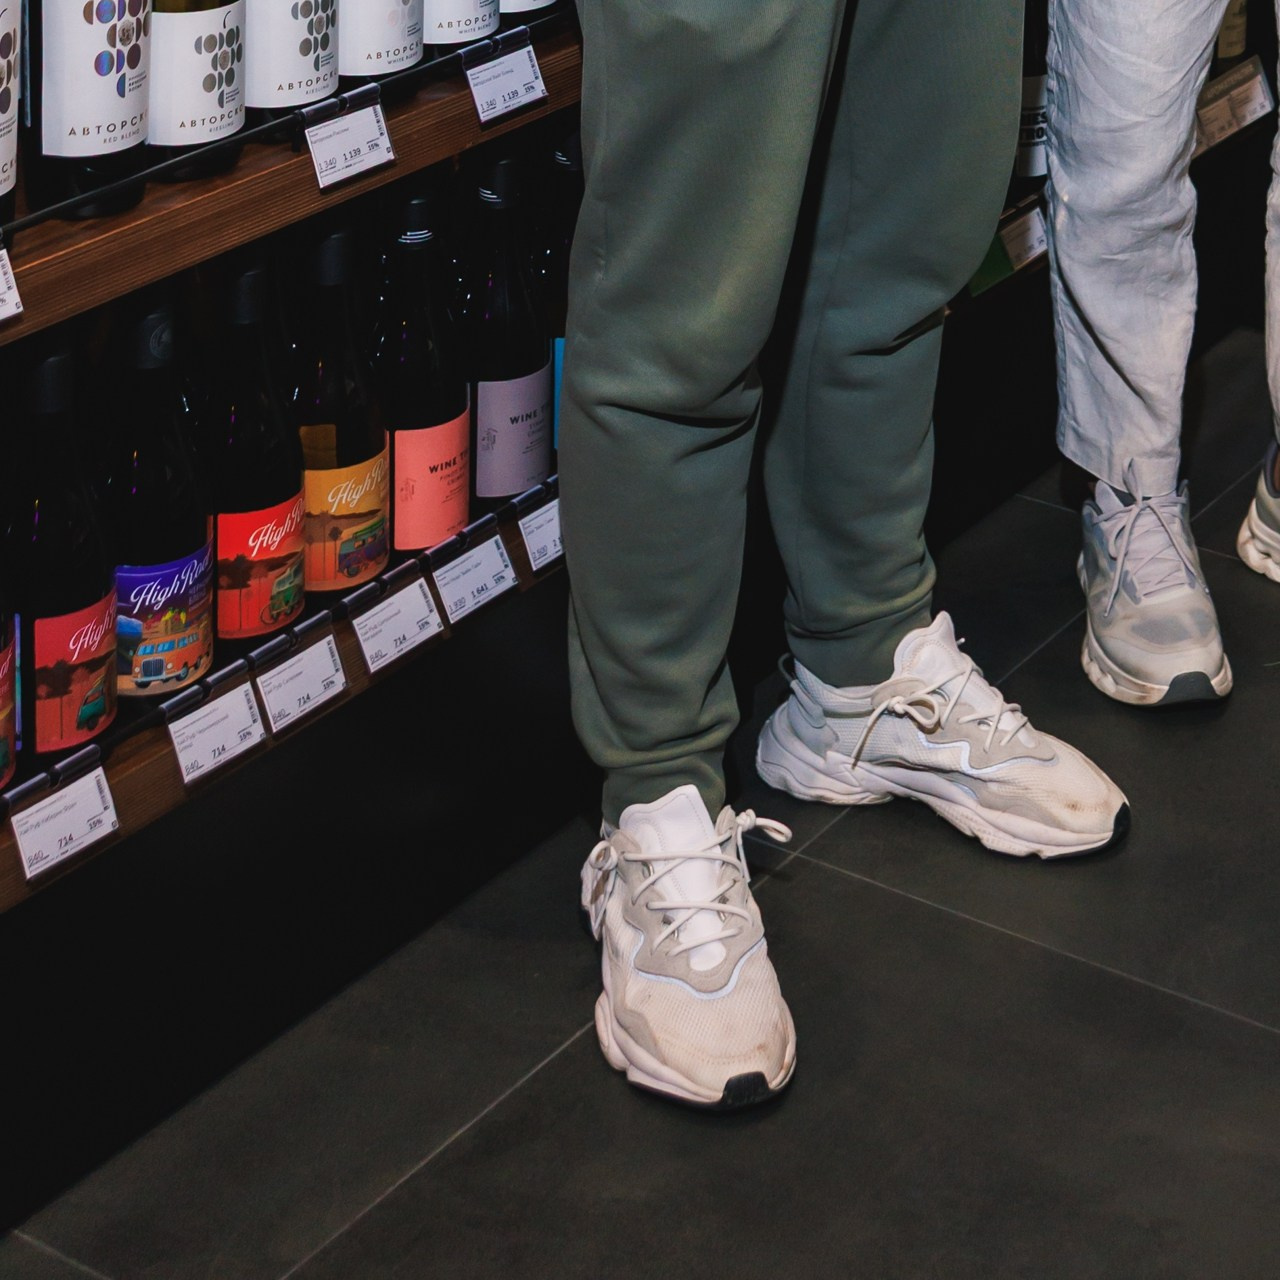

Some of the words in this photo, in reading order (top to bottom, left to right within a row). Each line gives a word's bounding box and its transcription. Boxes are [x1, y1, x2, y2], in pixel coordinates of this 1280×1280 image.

[485, 98, 497, 109] 340
[507, 89, 519, 100] 139
[525, 85, 535, 93] 15%
[323, 157, 337, 169] 340
[349, 147, 362, 159] 139
[367, 142, 380, 152] 15%
[509, 408, 538, 425] WINE
[428, 456, 457, 474] WINE
[327, 472, 371, 513] High
[248, 515, 292, 558] High
[130, 573, 180, 615] High
[476, 583, 489, 596] 641
[369, 649, 383, 663] 840
[394, 633, 407, 649] 714
[297, 693, 312, 709] 714
[211, 744, 227, 760] 714
[239, 730, 253, 742] 15%
[57, 833, 74, 850] 714
